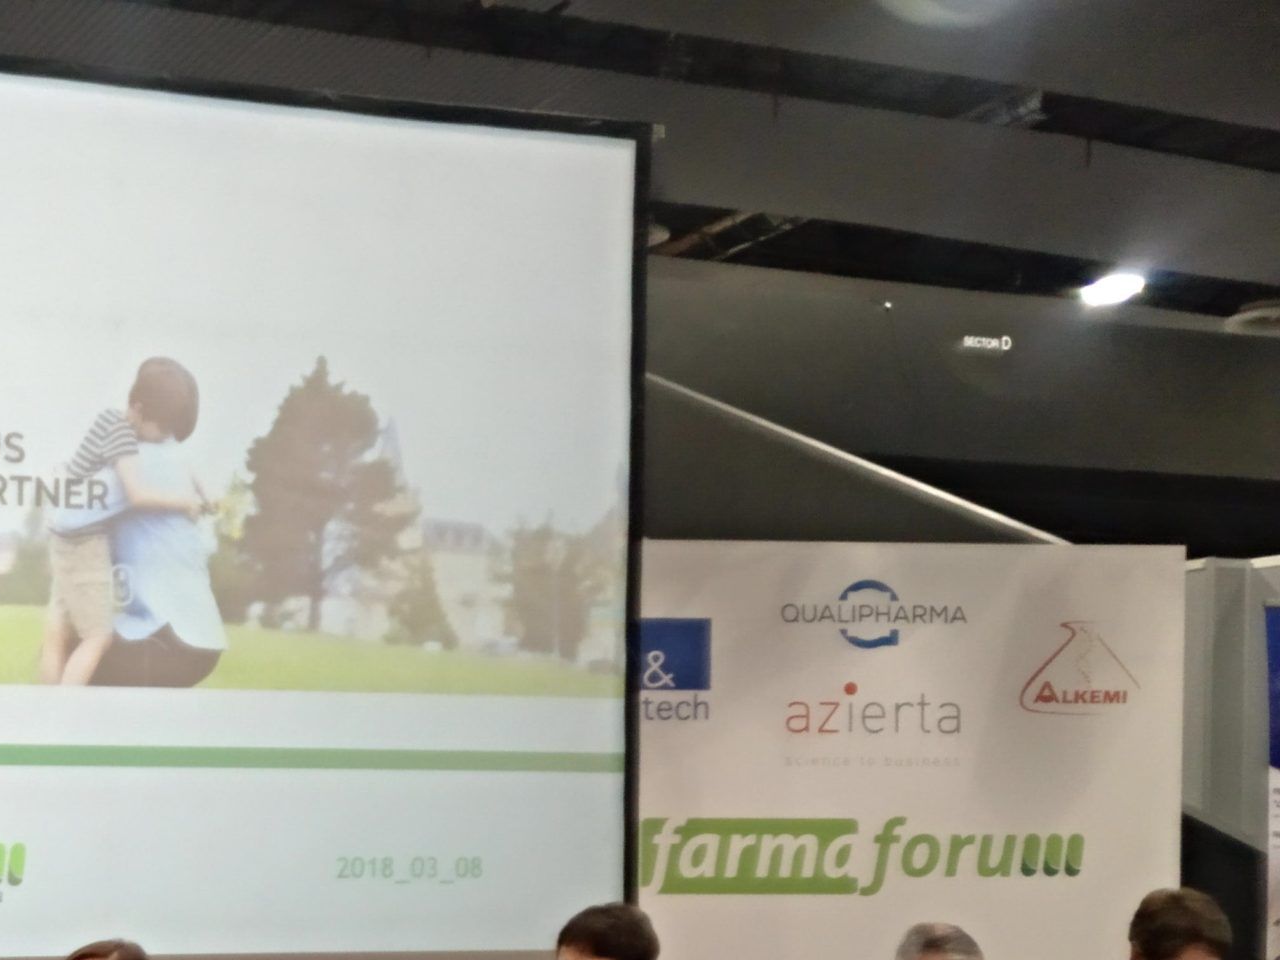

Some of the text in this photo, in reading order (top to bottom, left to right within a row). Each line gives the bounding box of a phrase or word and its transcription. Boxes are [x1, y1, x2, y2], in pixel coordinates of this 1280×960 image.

[1002, 335, 1012, 350] D
[780, 603, 967, 624] QUALIPHARMA
[1033, 681, 1128, 704] ALKEMI
[785, 682, 961, 735] azierta
[336, 856, 483, 884] 2018_03_08
